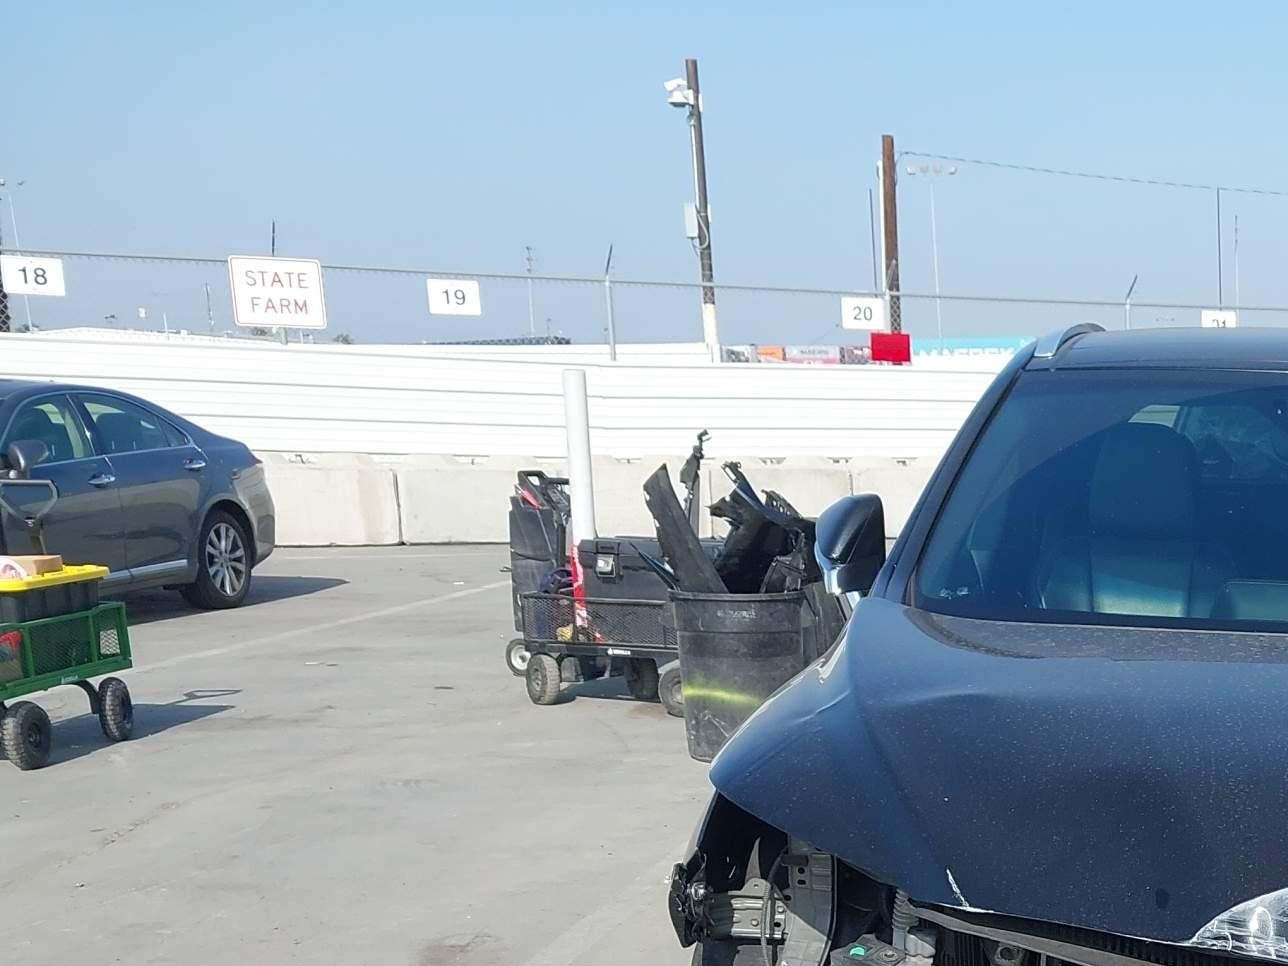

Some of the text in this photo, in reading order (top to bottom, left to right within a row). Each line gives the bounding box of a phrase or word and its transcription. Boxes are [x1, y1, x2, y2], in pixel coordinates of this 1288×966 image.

[17, 266, 48, 286] 18
[244, 270, 309, 289] STATE
[250, 296, 309, 315] FARM
[441, 288, 466, 306] 19
[852, 305, 873, 322] 20
